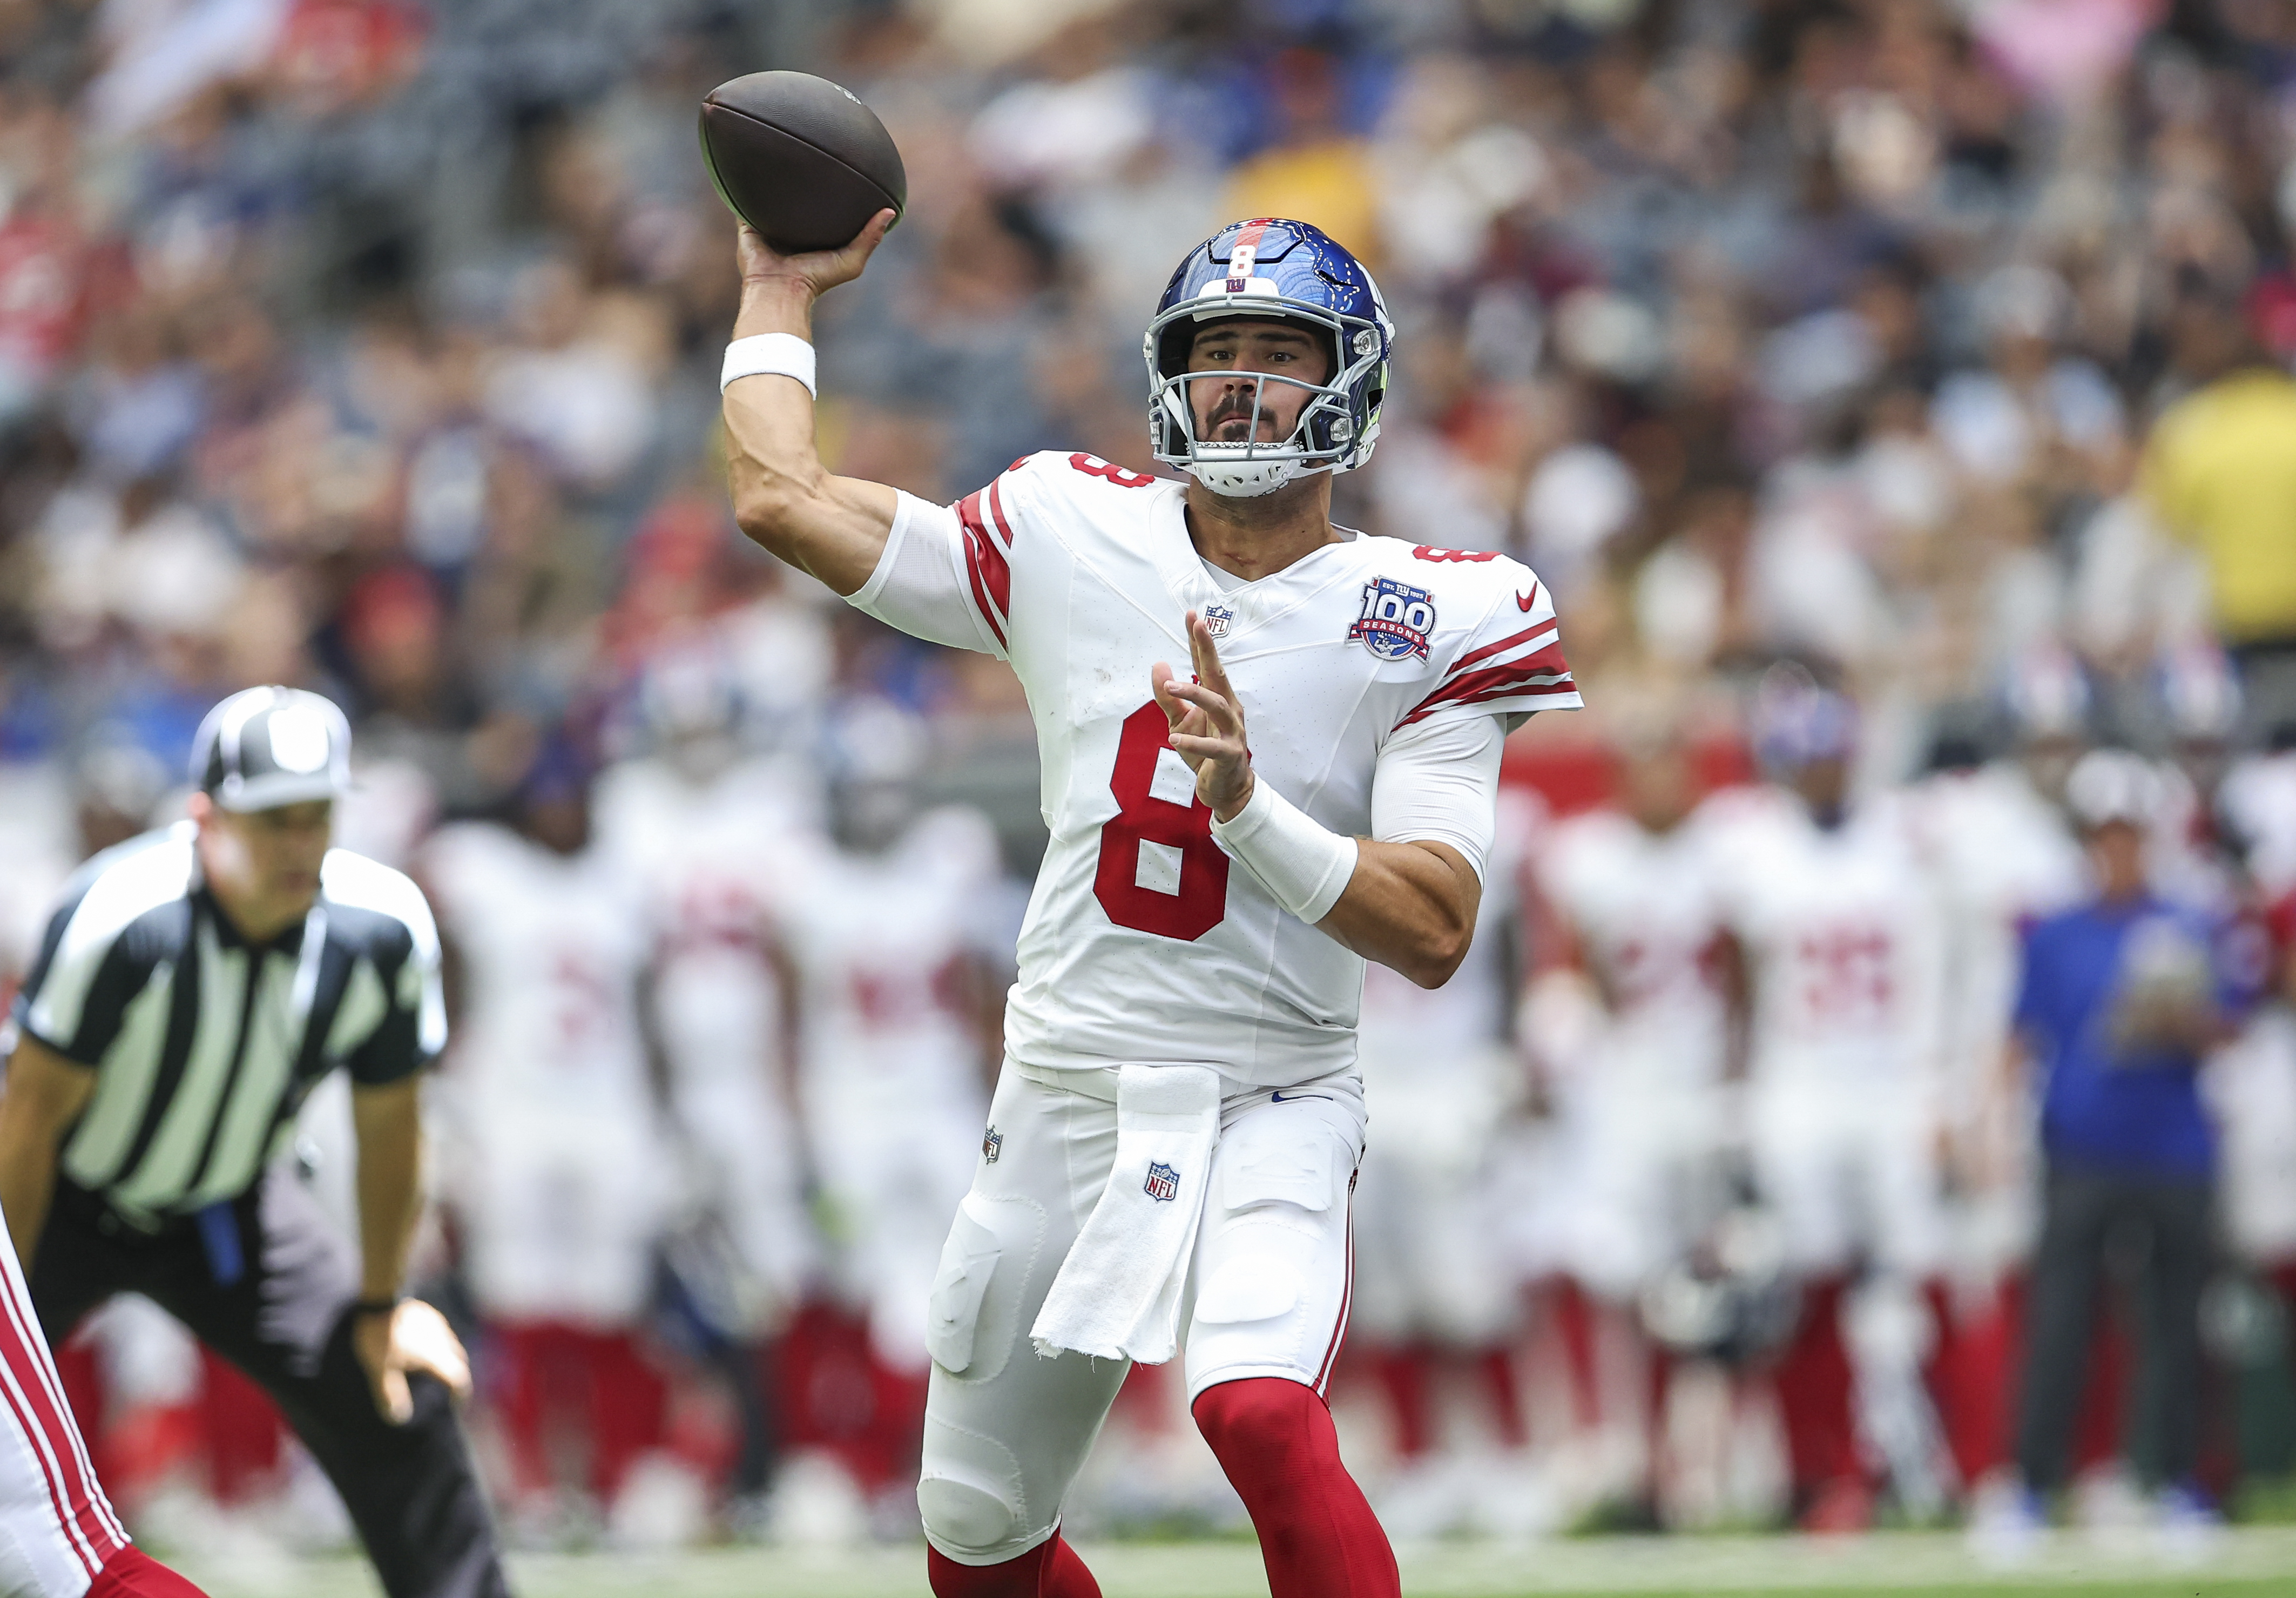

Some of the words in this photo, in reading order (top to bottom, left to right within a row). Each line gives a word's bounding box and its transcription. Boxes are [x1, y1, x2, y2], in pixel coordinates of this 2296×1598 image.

[1228, 245, 1256, 277] 8
[1069, 453, 1156, 488] 8
[1412, 544, 1502, 562] 8
[1382, 582, 1395, 591] EST.
[1410, 591, 1424, 599] 1925
[1362, 587, 1434, 633] 100
[1207, 617, 1225, 633] NFL
[1363, 621, 1421, 642] SEASONS
[1093, 699, 1252, 942] 8
[1147, 1176, 1173, 1198] NFL
